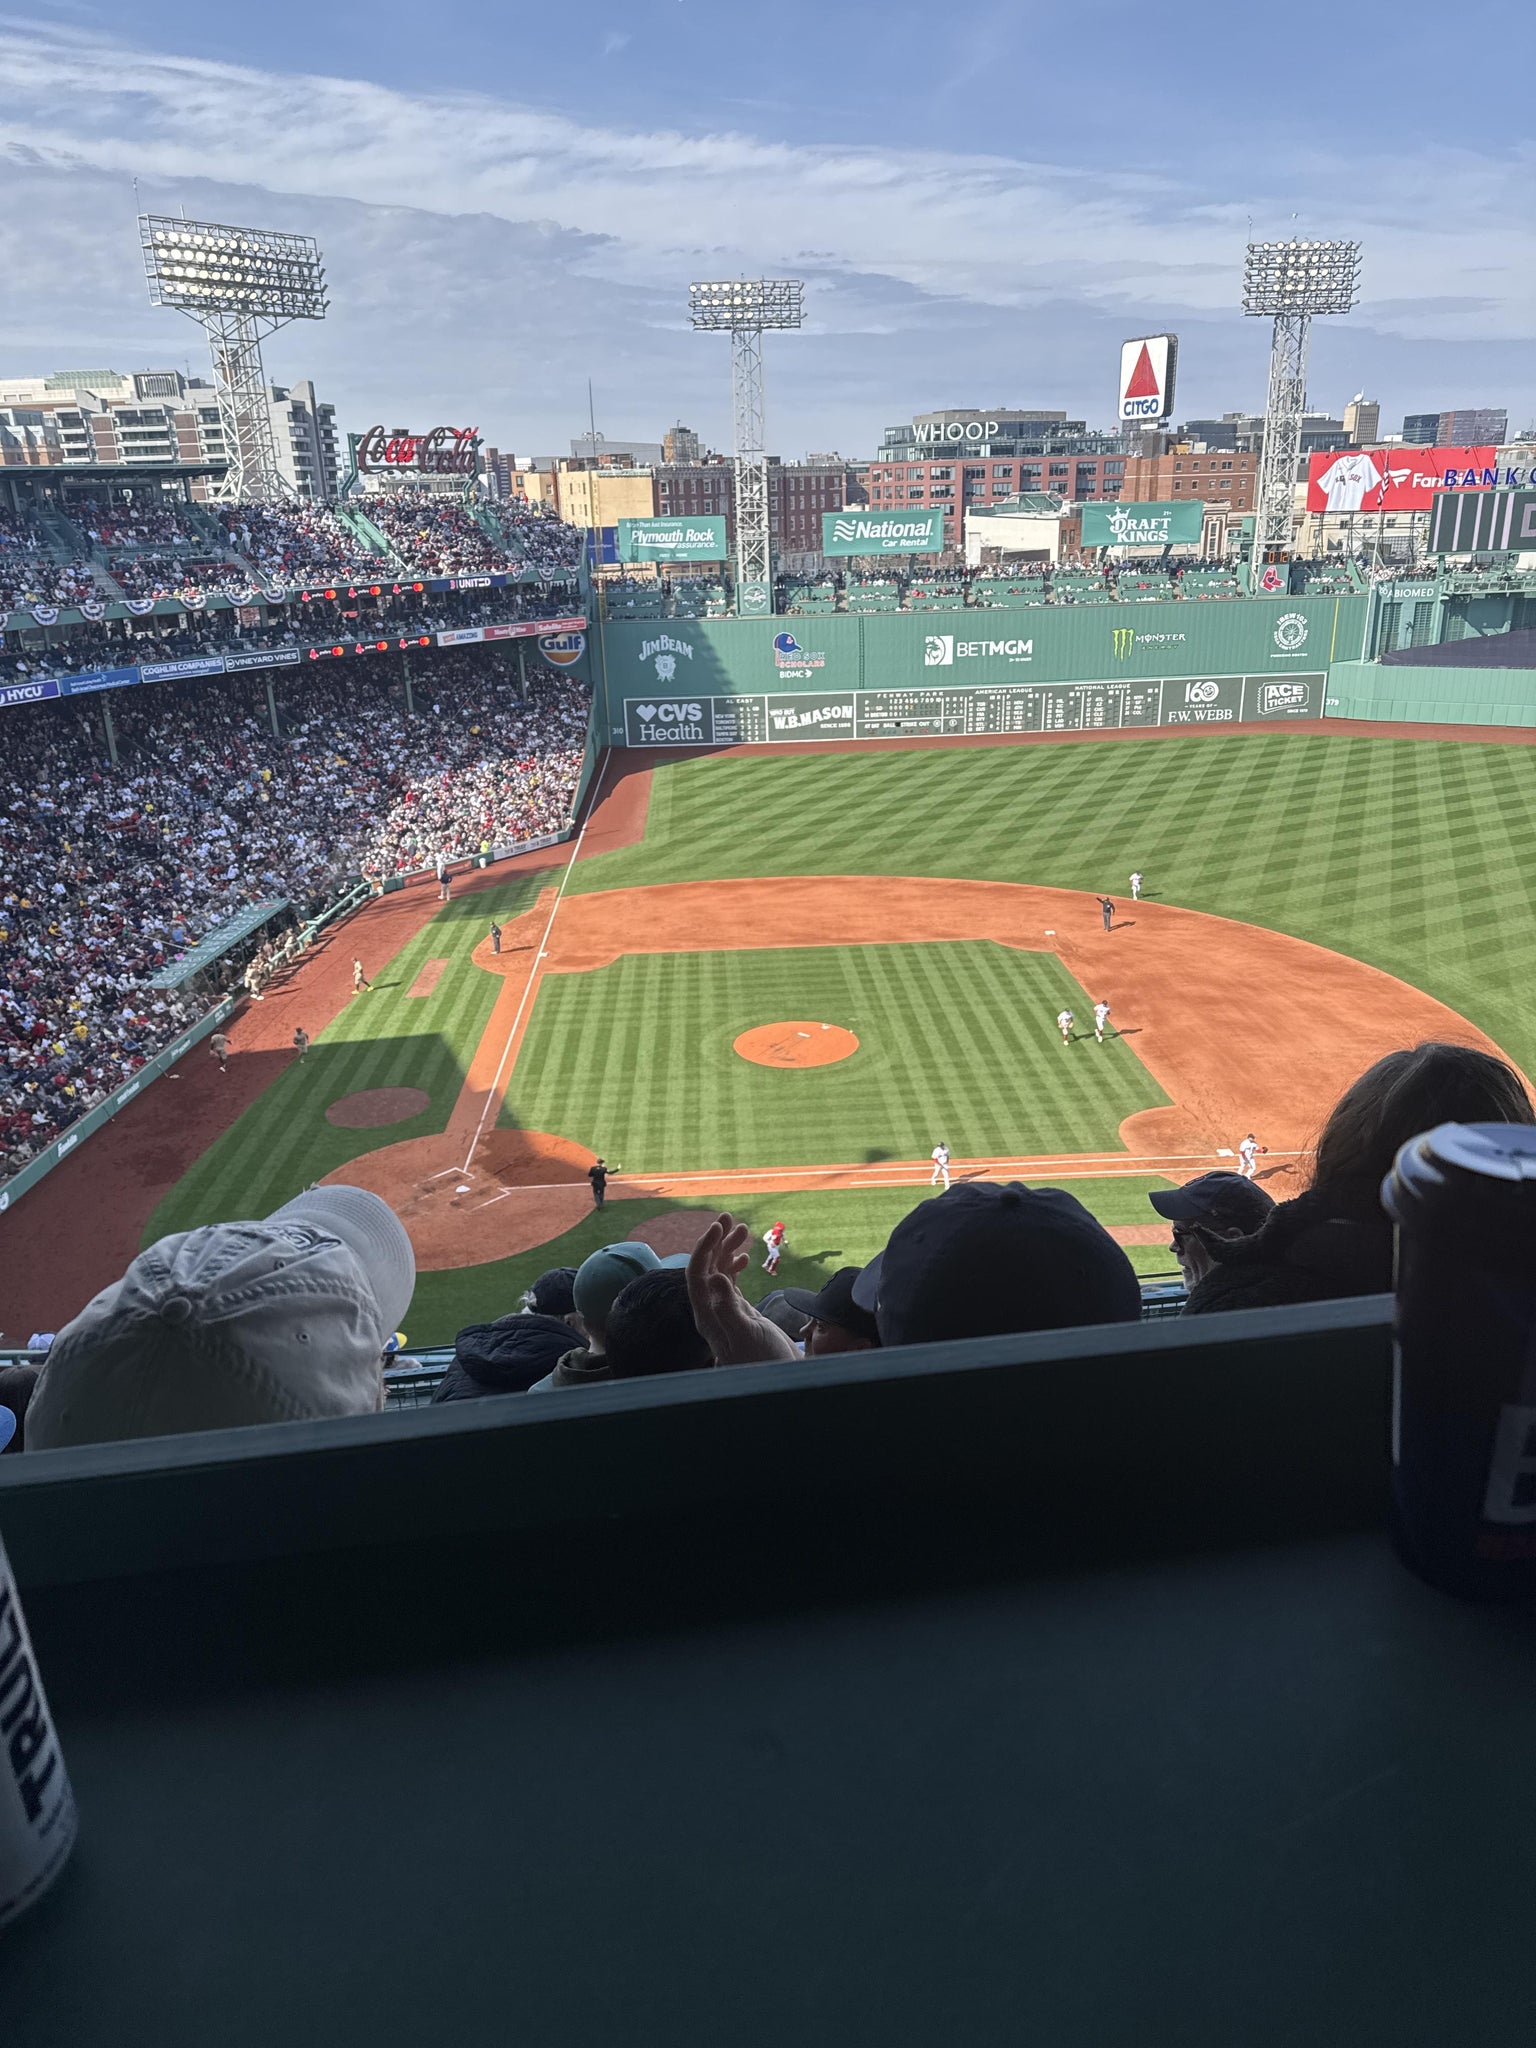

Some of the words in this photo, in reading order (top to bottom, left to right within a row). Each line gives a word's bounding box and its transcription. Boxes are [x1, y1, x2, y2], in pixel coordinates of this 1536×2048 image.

[1124, 398, 1158, 416] CITGO
[912, 421, 999, 443] WHOOP
[1444, 466, 1519, 486] BANK
[1110, 518, 1171, 533] DRAFT
[631, 530, 683, 544] Plymouth
[686, 528, 714, 542] Rock
[900, 538, 928, 546] Rental
[1116, 530, 1169, 542] KINGS
[459, 578, 491, 588] UNITED
[1386, 588, 1434, 598] ABIOMED
[1277, 613, 1296, 625] IBEW
[540, 634, 582, 650] Gulf
[1135, 633, 1186, 643] MONSTER
[638, 640, 660, 661] JIM
[660, 634, 694, 660] BEAM
[956, 640, 1033, 657] BETMGM
[235, 656, 274, 666] VINEYARD
[274, 653, 297, 661] VINES
[779, 652, 801, 660] RED
[803, 652, 825, 660] SOX
[142, 665, 177, 675] COGHLIN
[178, 660, 222, 671] COMPANIES
[780, 660, 825, 668] SCHOLARS
[8, 686, 42, 701] HYCU
[1267, 684, 1304, 699] ACE
[1268, 696, 1303, 708] TICKET
[658, 703, 702, 722] CVS
[1168, 711, 1190, 722] F.W.
[1194, 708, 1233, 721] WEBB
[640, 723, 703, 741] Health
